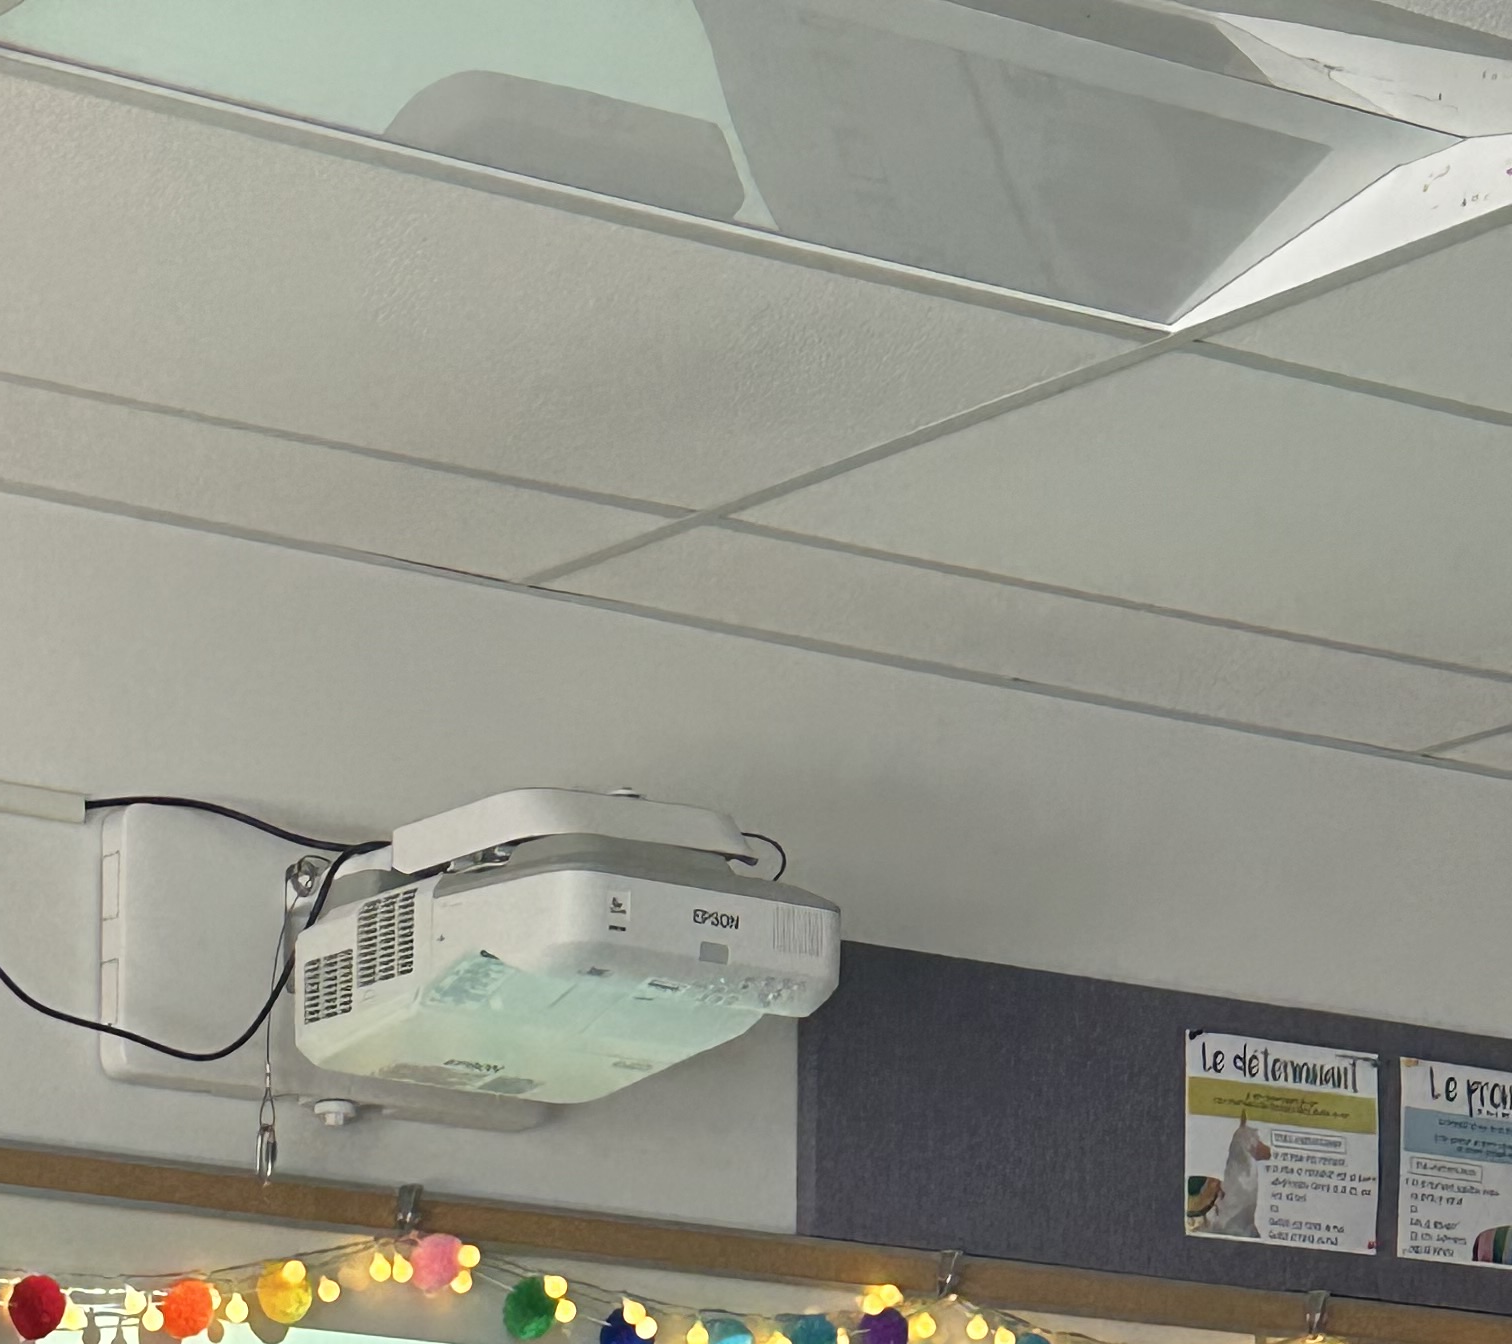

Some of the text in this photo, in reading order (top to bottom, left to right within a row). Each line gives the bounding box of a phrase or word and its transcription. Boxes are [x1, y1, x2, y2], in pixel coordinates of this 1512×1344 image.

[693, 908, 740, 930] EPSON
[1202, 1042, 1225, 1073] Le
[1430, 1066, 1458, 1102] Le
